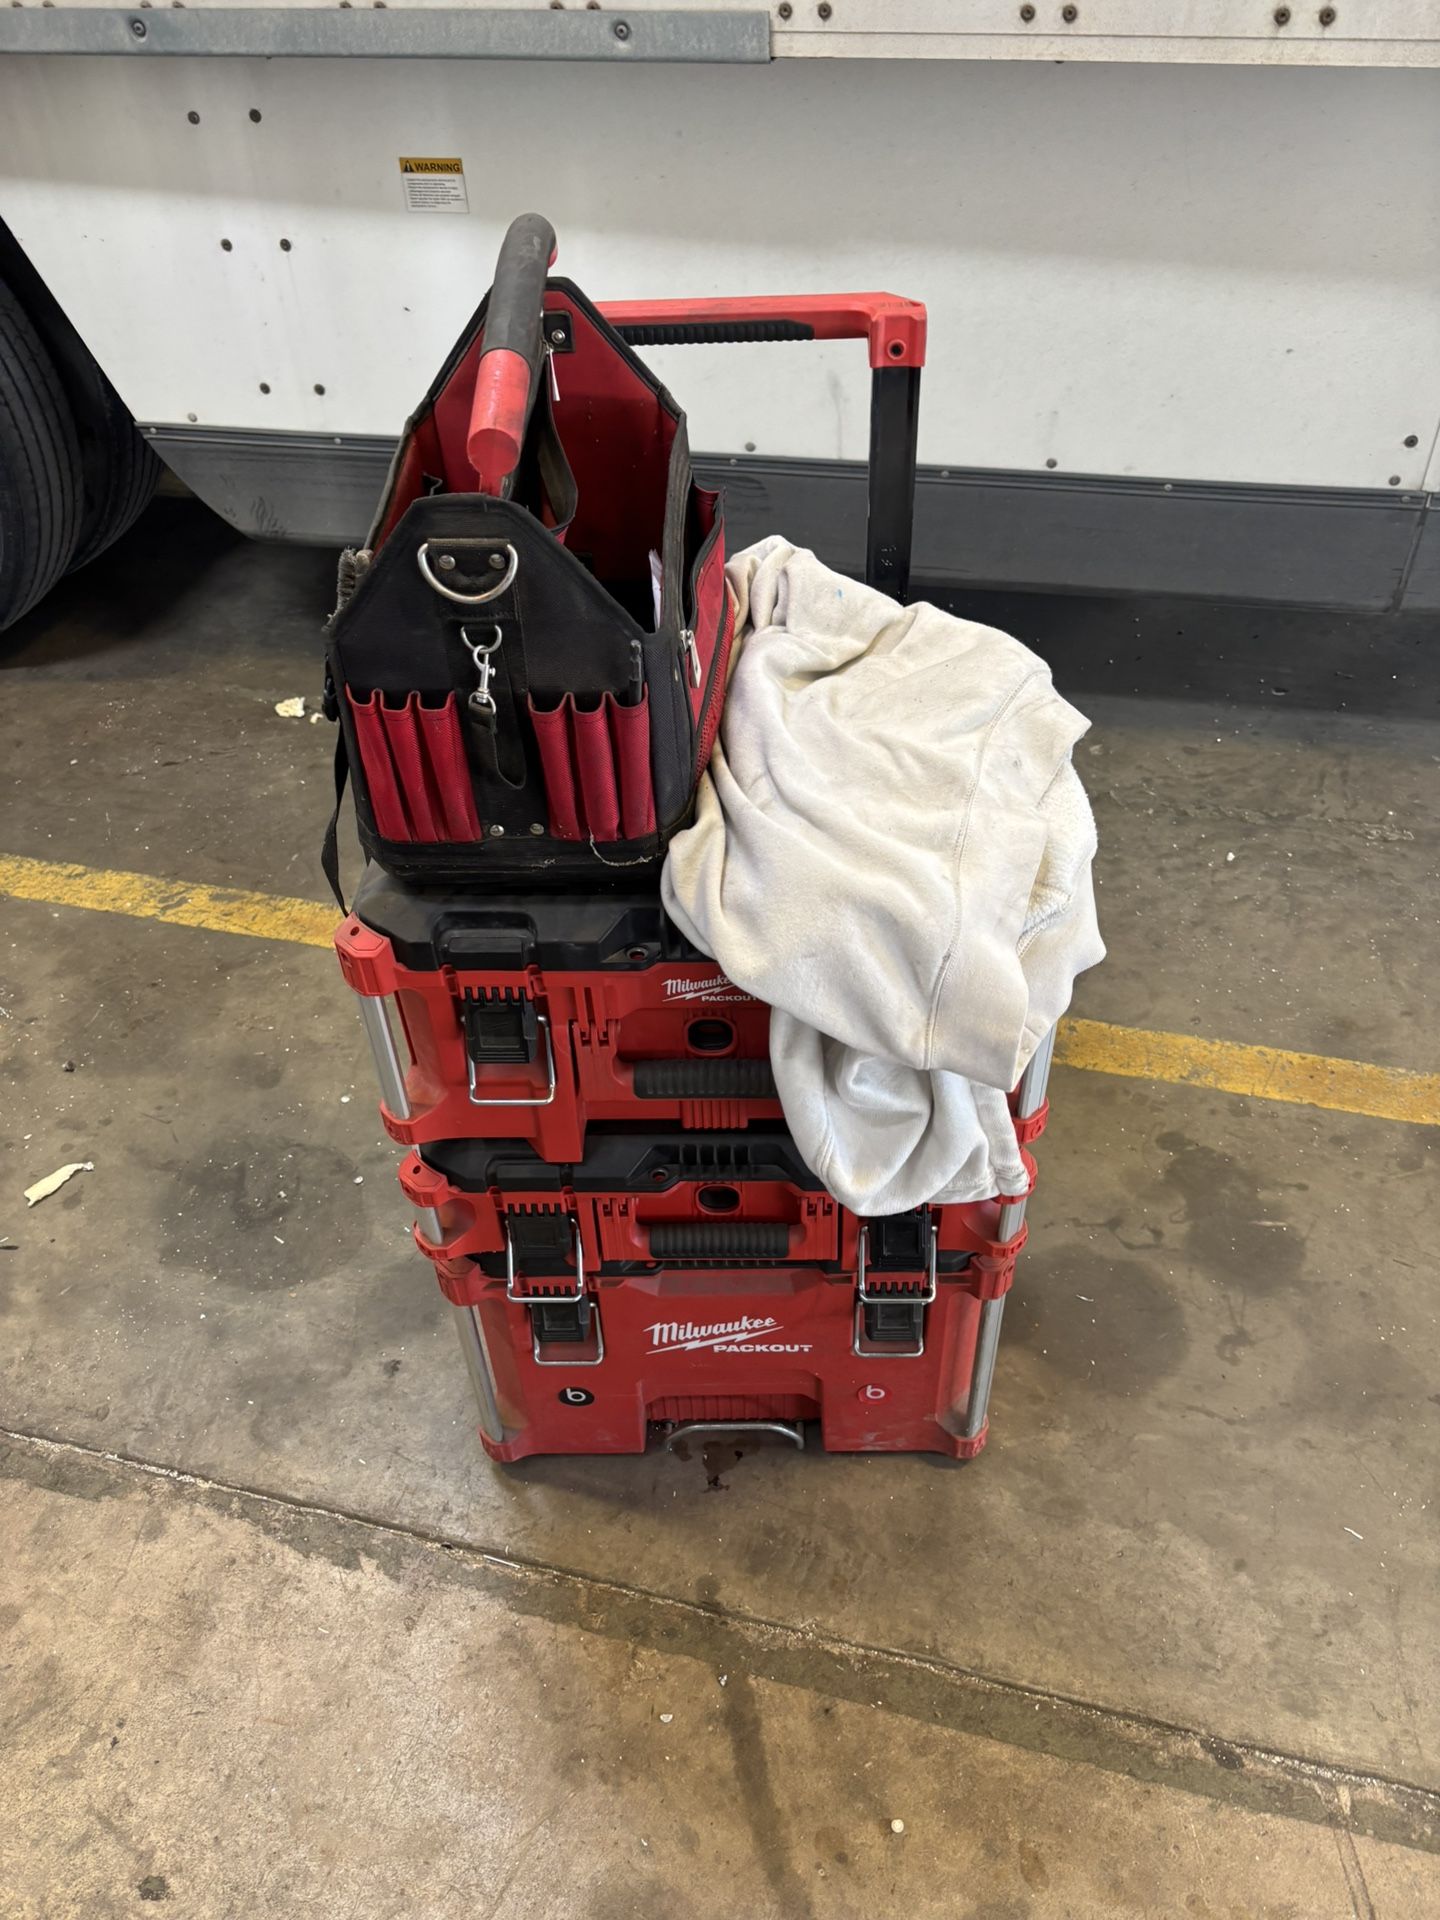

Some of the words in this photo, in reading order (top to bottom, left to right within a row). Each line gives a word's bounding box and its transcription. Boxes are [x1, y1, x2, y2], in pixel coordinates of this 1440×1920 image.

[414, 162, 460, 172] WARNING
[661, 975, 731, 996] Milwauke
[643, 1315, 777, 1346] Milwaukee
[713, 1344, 813, 1354] PACKOUT
